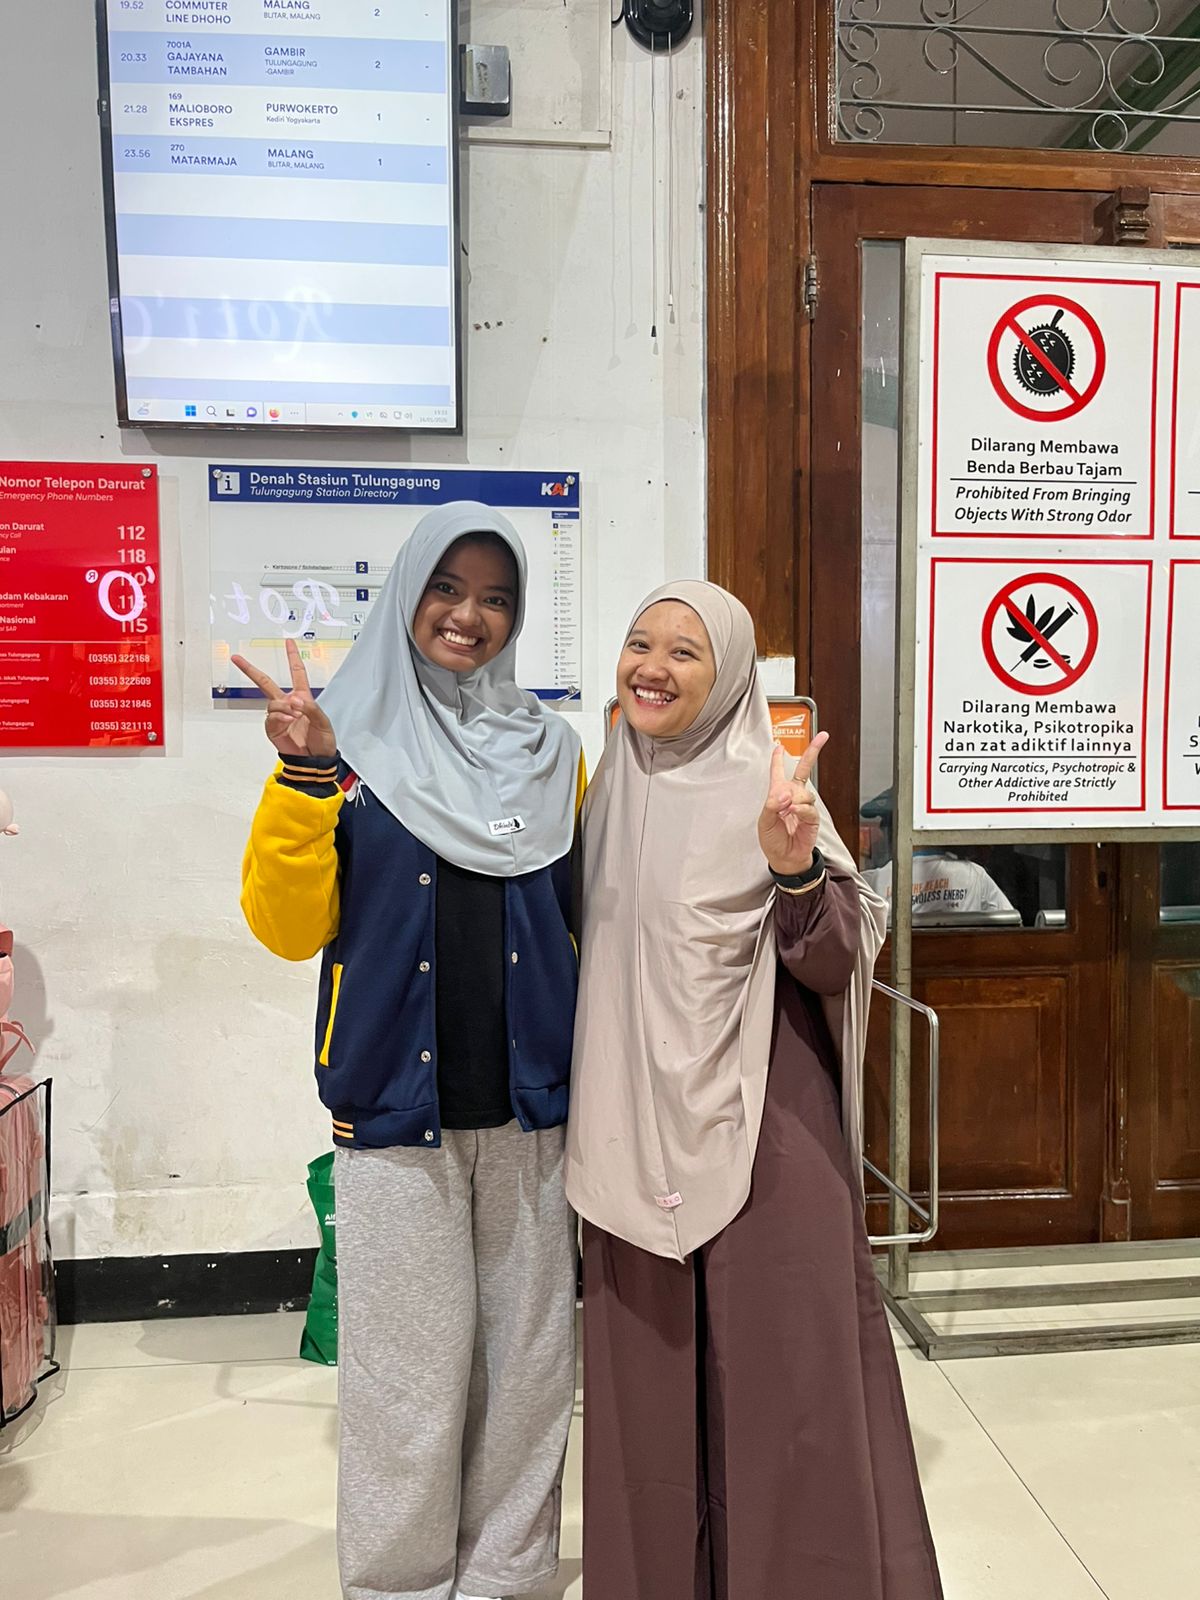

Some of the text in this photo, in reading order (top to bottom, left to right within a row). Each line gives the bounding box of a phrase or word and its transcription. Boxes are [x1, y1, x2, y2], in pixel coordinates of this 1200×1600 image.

[120, 1, 144, 10] 19.52
[165, 0, 228, 11] COMMUTER
[263, 0, 310, 10] MALANG
[289, 13, 321, 21] MALANG
[374, 8, 380, 17] 2
[166, 14, 231, 25] LINE DHOHO
[166, 41, 192, 49] 7001A
[120, 53, 147, 62] 20.33
[167, 52, 224, 63] GAJAYANA
[264, 47, 306, 57] GAMBIR
[375, 60, 381, 69] 2
[168, 66, 227, 76] TAMBAHAN
[168, 93, 183, 101] 169
[124, 105, 148, 114] 21.28
[169, 104, 233, 115] MALIOBORO
[266, 103, 338, 115] PURWOKERTO
[169, 117, 214, 128] EKSPRES
[124, 149, 151, 158] 23.56
[170, 144, 185, 152] 270
[267, 148, 314, 159] MALANG
[171, 155, 237, 167] MATARMAJA
[294, 162, 325, 170] MALANG
[971, 437, 1119, 456] Dilarang Membawa
[967, 460, 1122, 480] Benda Berbau Tajam
[0, 476, 146, 491] Nomor Telepon Darurat
[250, 472, 441, 491] Denah Stasiun Tulungagung
[0, 492, 114, 502] Emergency Phone Numbers
[250, 486, 399, 500] Tulungagung Station Directory
[955, 486, 1131, 505] Prohibited From Bringing
[954, 507, 1132, 526] Objects With Strong Odor
[12, 522, 45, 531] Darurat
[117, 525, 146, 541] 112
[117, 548, 146, 564] 118
[23, 592, 69, 601] Kebakaran
[0, 616, 36, 625] Nasional
[88, 653, 117, 664] (0355)
[89, 676, 118, 686] (0355)
[90, 699, 119, 709] (0355)
[962, 700, 1116, 717] Dilarang Membawa
[90, 721, 152, 732] (0355) 321113
[944, 720, 1134, 737] Narkotika, Psikotropika
[945, 738, 1132, 754] dan zat adiktif lainnya
[938, 763, 1136, 776] Carrying Narcotics, Psychotropic &
[958, 777, 1116, 790] Other Addictive are Strictly
[1007, 791, 1068, 802] Prohibited
